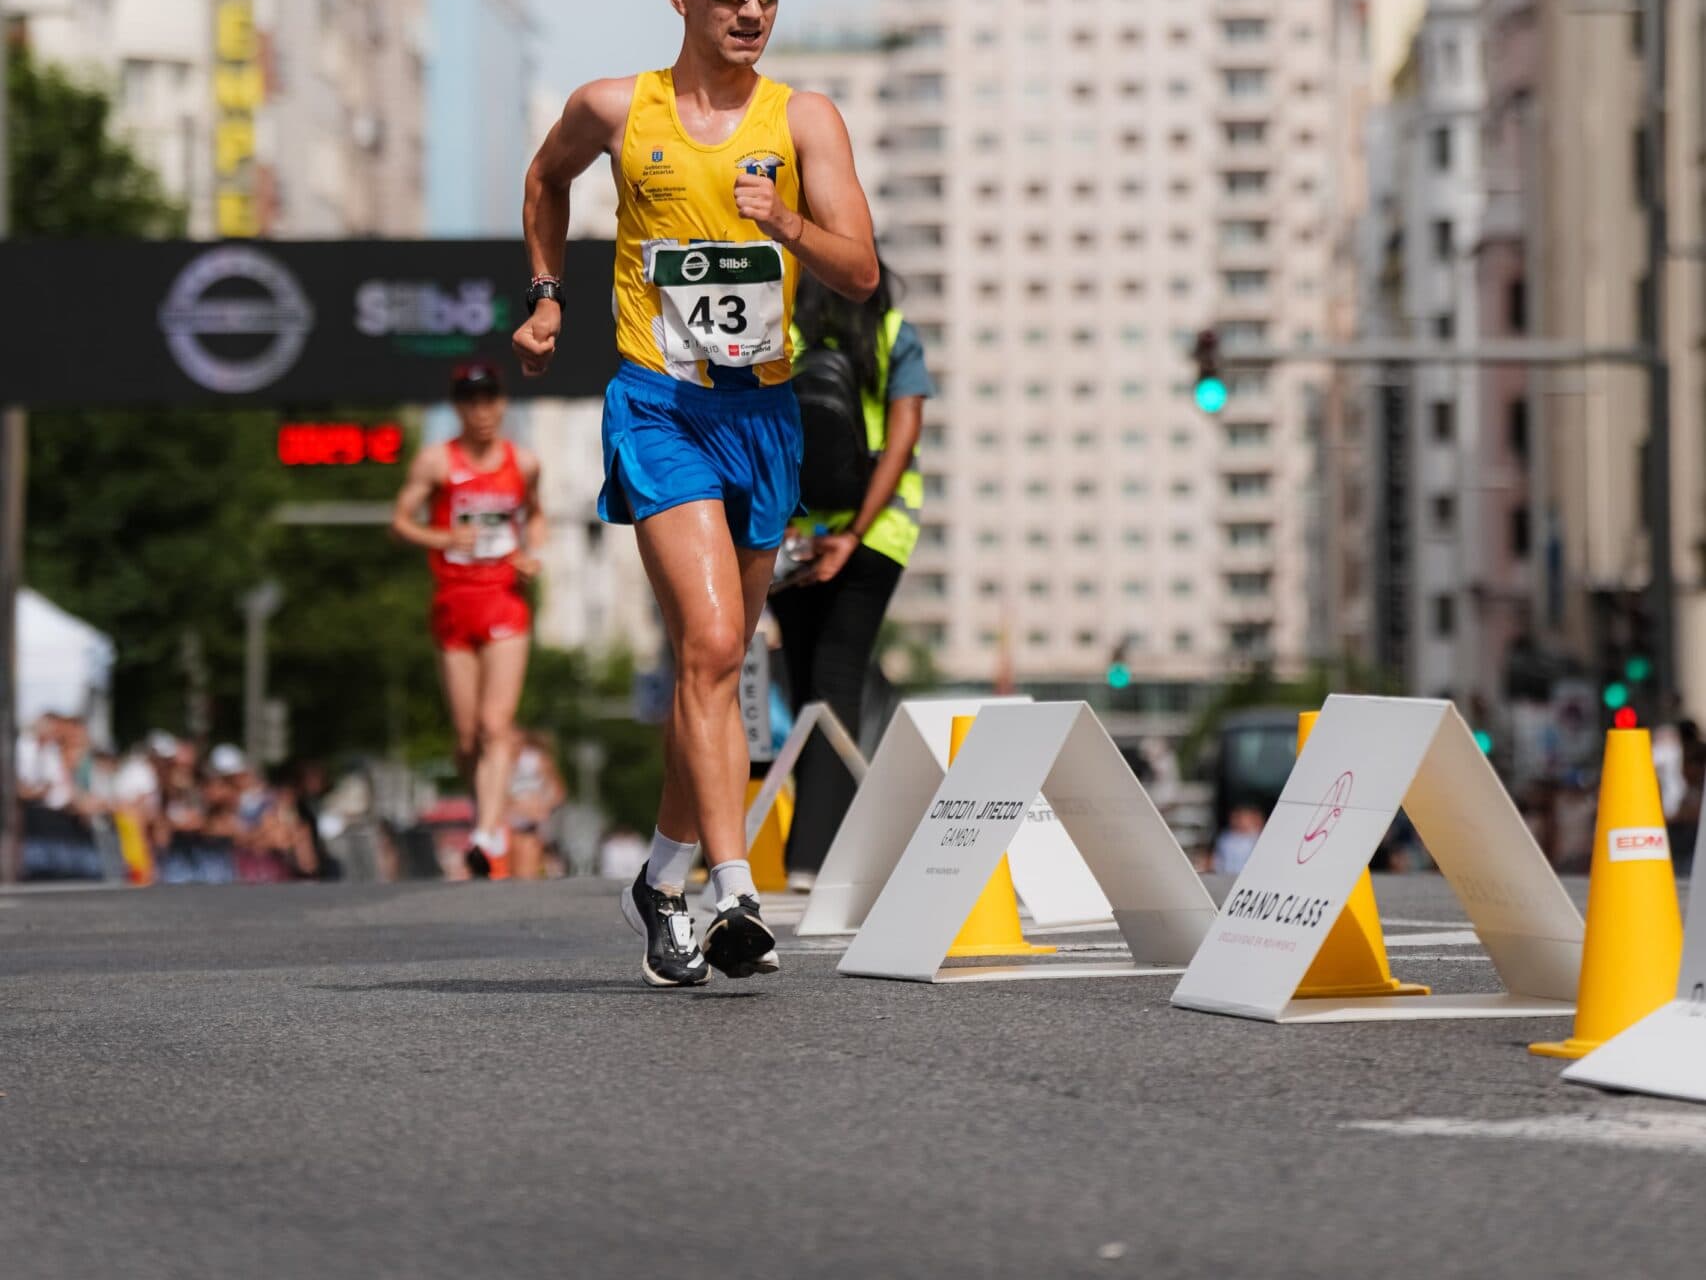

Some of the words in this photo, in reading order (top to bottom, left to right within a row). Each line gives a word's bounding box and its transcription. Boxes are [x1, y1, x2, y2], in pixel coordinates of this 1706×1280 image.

[719, 257, 749, 270] Silbö
[687, 295, 748, 335] 43
[941, 827, 981, 847] GAMBOA
[1228, 888, 1280, 920] GRAND
[1275, 894, 1329, 928] CLASS
